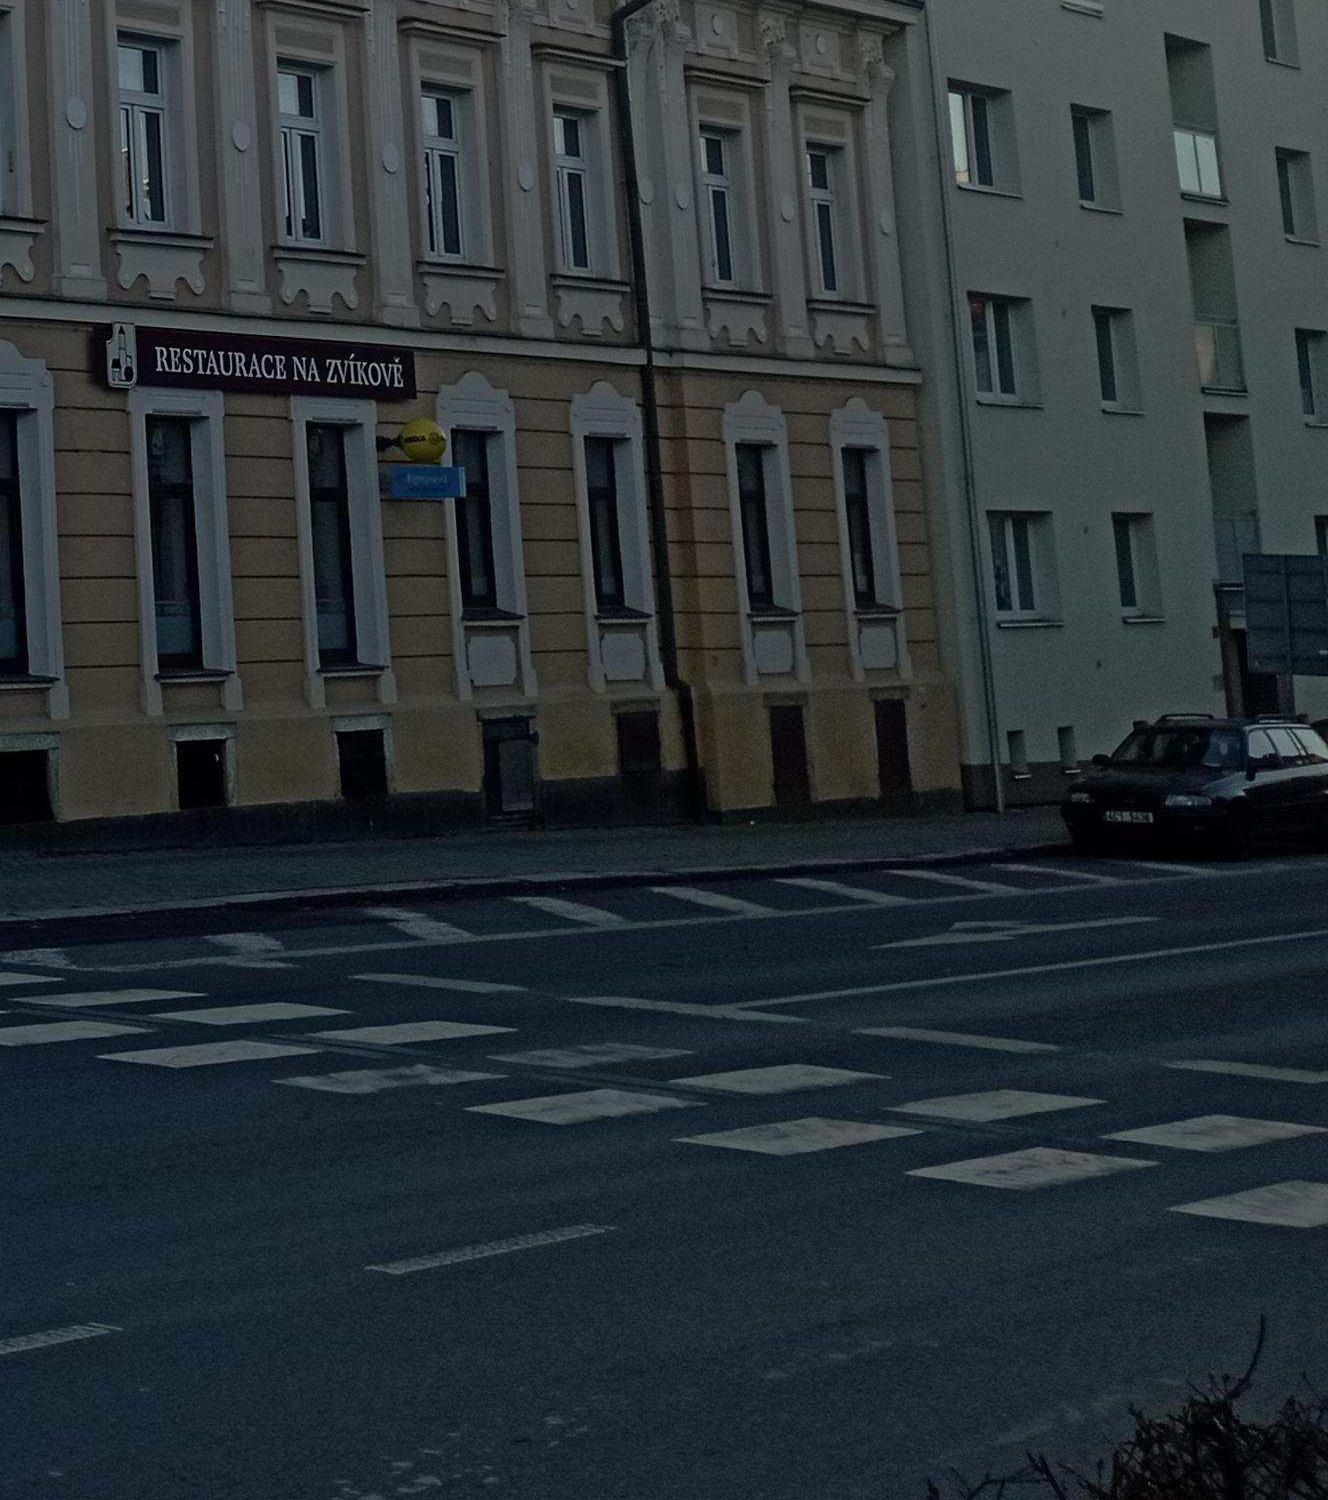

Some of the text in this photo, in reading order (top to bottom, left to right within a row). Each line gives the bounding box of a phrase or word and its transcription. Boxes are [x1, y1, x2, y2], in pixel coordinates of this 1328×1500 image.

[154, 345, 404, 388] RESTAURACE NA ZVÍKOVĚ
